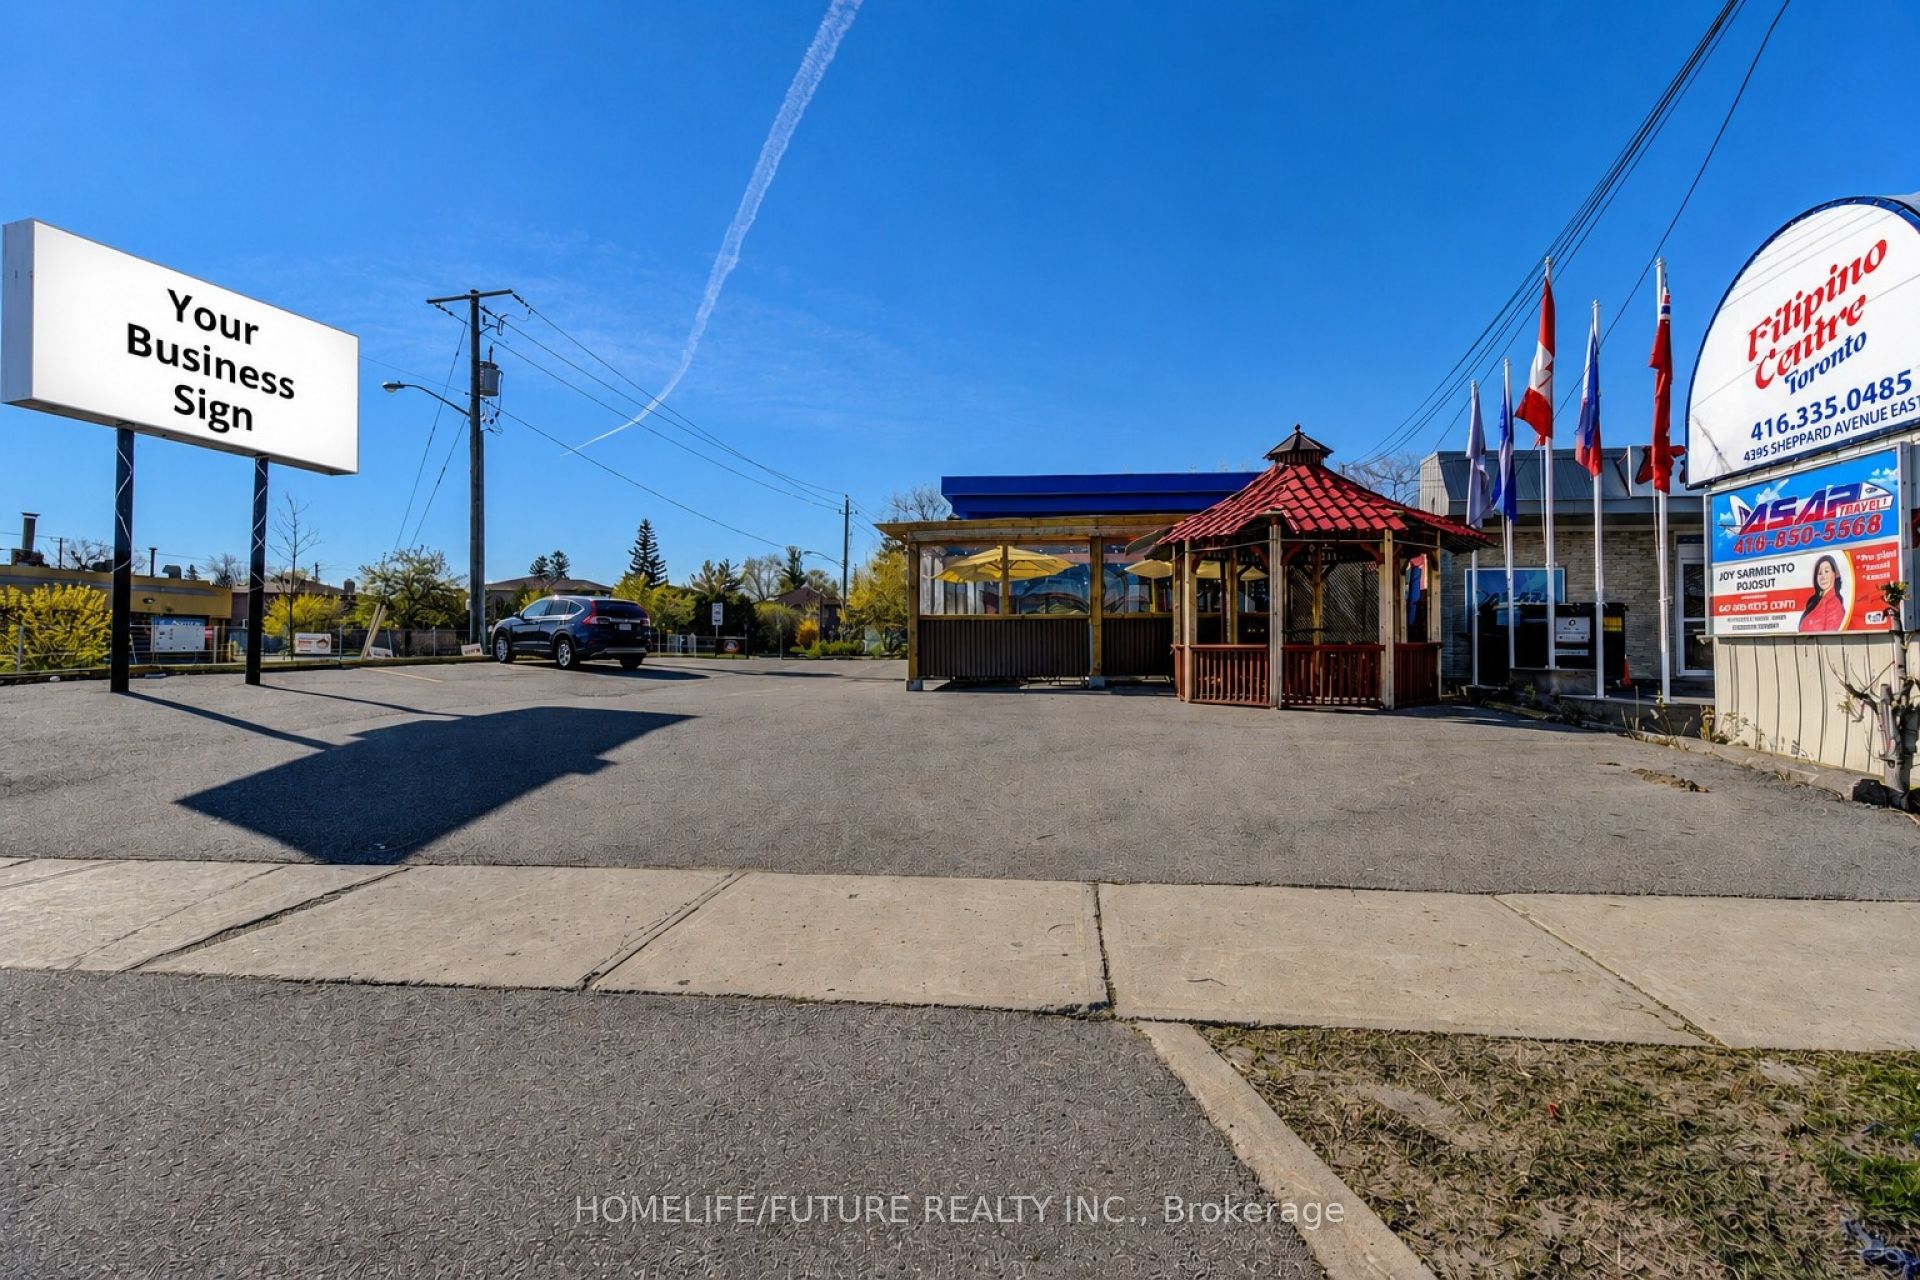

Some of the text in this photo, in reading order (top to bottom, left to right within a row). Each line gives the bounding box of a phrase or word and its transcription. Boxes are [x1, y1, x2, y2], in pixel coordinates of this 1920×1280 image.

[167, 288, 259, 345] Your
[1746, 239, 1887, 362] Filipino
[127, 322, 295, 400] Business
[1755, 294, 1866, 390] Centre
[1784, 331, 1867, 395] Toronto
[173, 384, 252, 433] Sign
[1743, 446, 1769, 461] 4395
[1770, 424, 1832, 455] SHEPPARD
[1834, 406, 1888, 436] AVENUE
[1750, 369, 1912, 441] 416.335.0485
[1719, 562, 1796, 582] JOY SARMIENTO
[1736, 578, 1776, 591] POJOSUT
